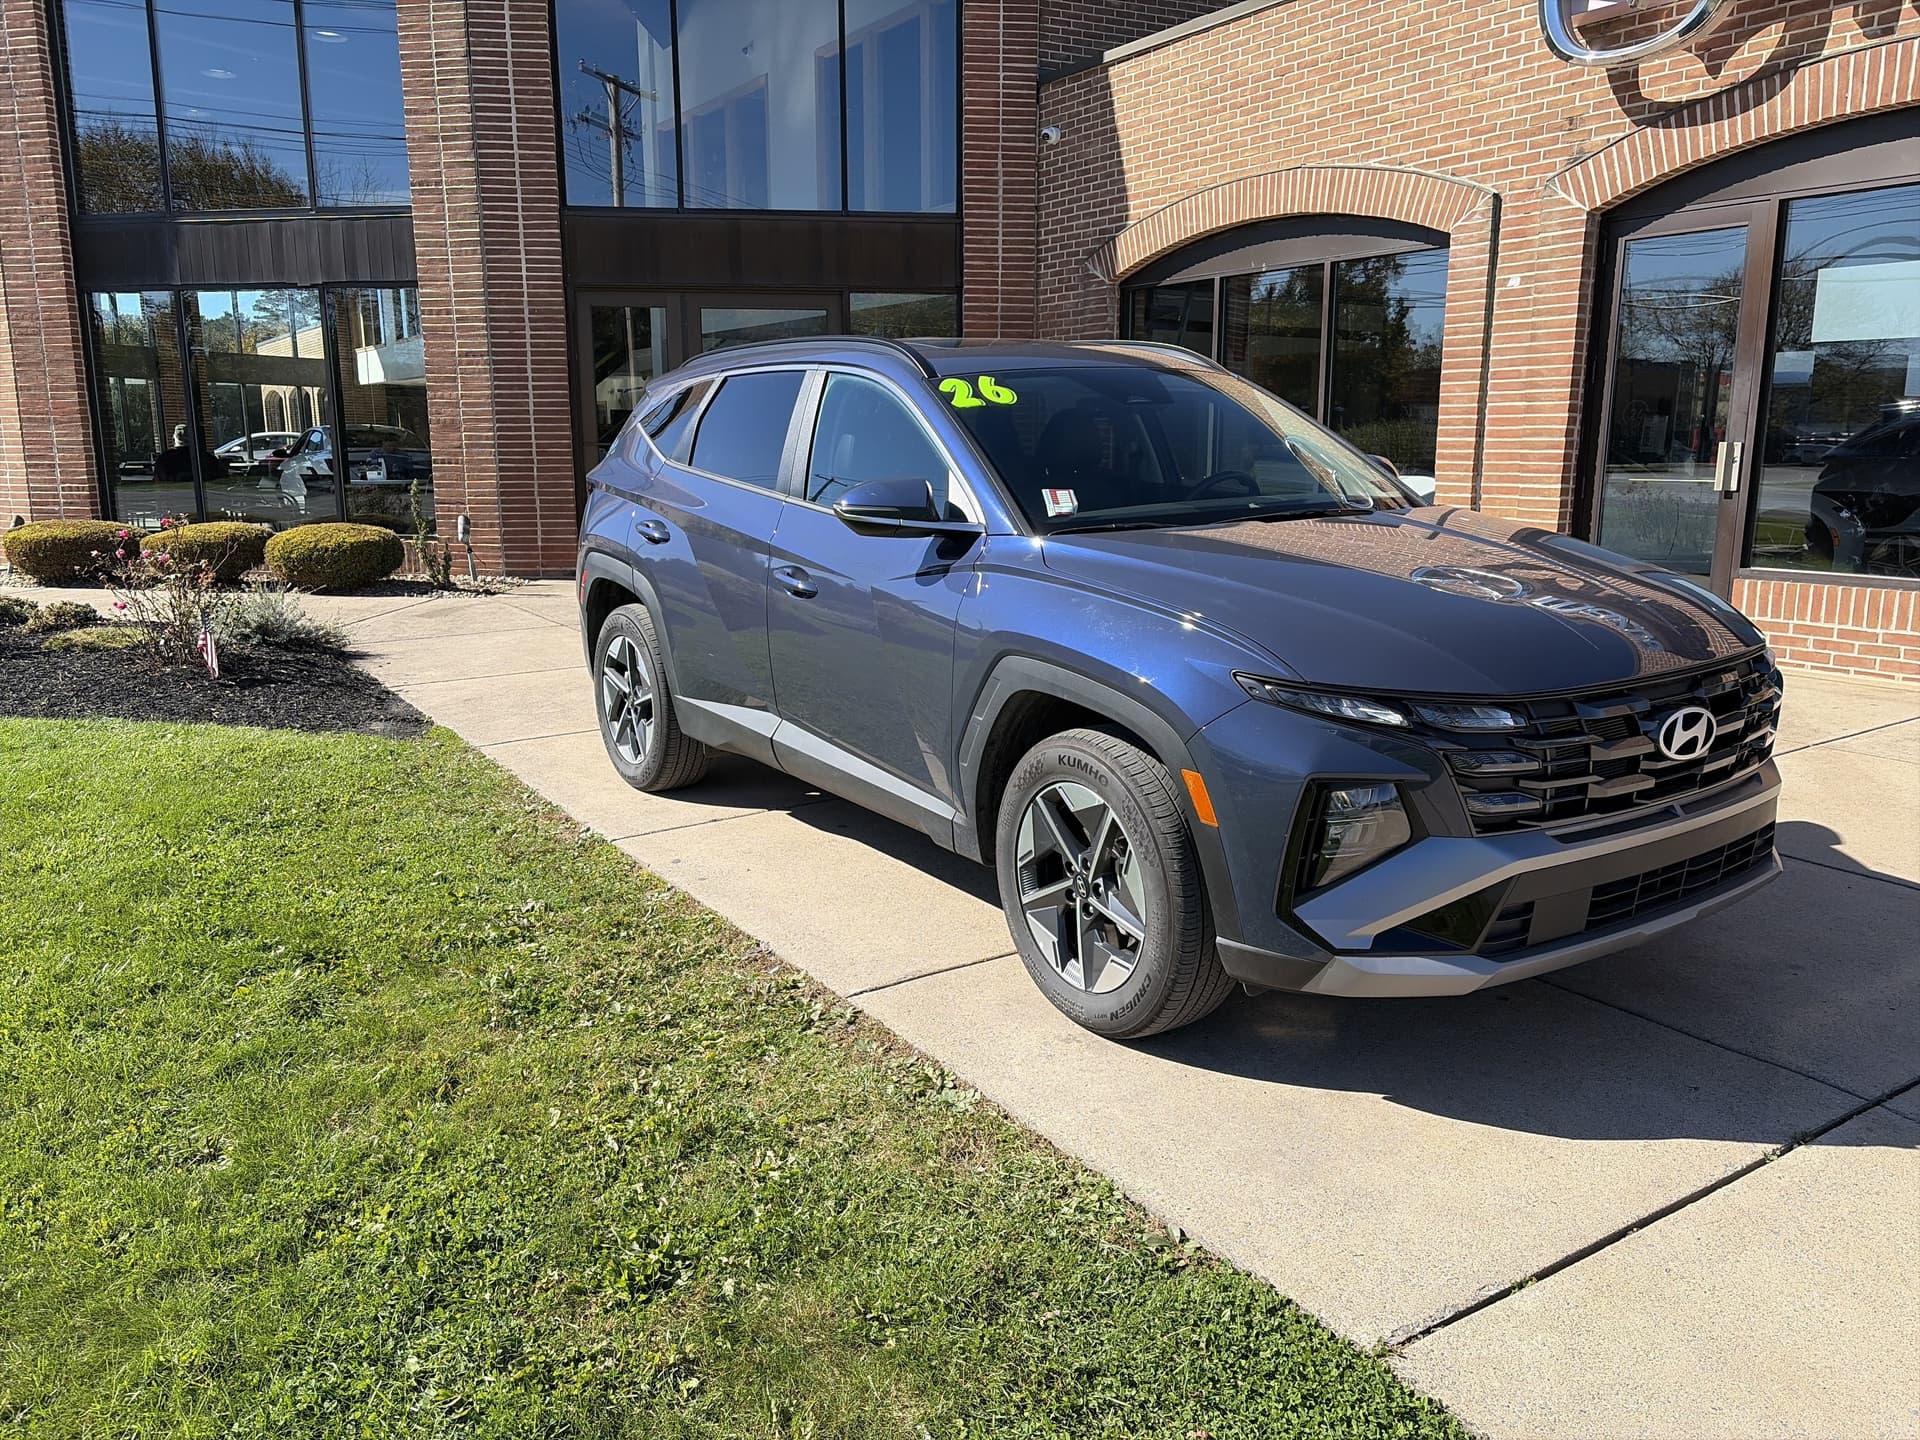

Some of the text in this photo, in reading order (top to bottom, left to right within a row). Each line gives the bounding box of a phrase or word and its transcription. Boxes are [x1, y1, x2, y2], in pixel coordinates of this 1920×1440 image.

[938, 375, 1018, 408] 26
[1058, 754, 1109, 787] KUMHO
[1109, 973, 1152, 1021] CRUGEN
